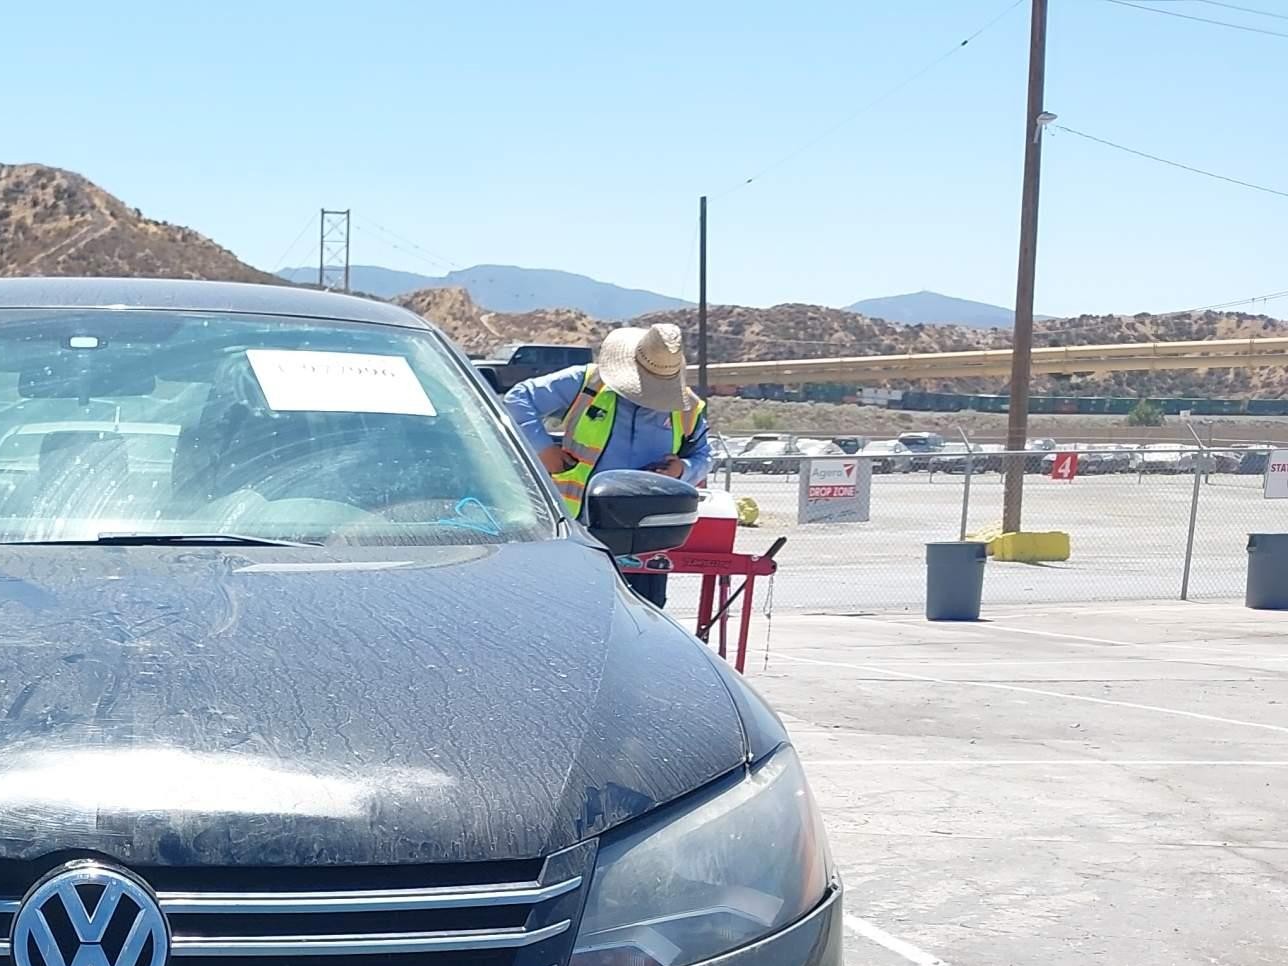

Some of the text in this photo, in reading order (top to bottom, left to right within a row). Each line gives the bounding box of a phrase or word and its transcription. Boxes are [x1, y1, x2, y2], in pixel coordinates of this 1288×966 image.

[1058, 456, 1072, 478] 4
[809, 486, 855, 497] DROP ZONE
